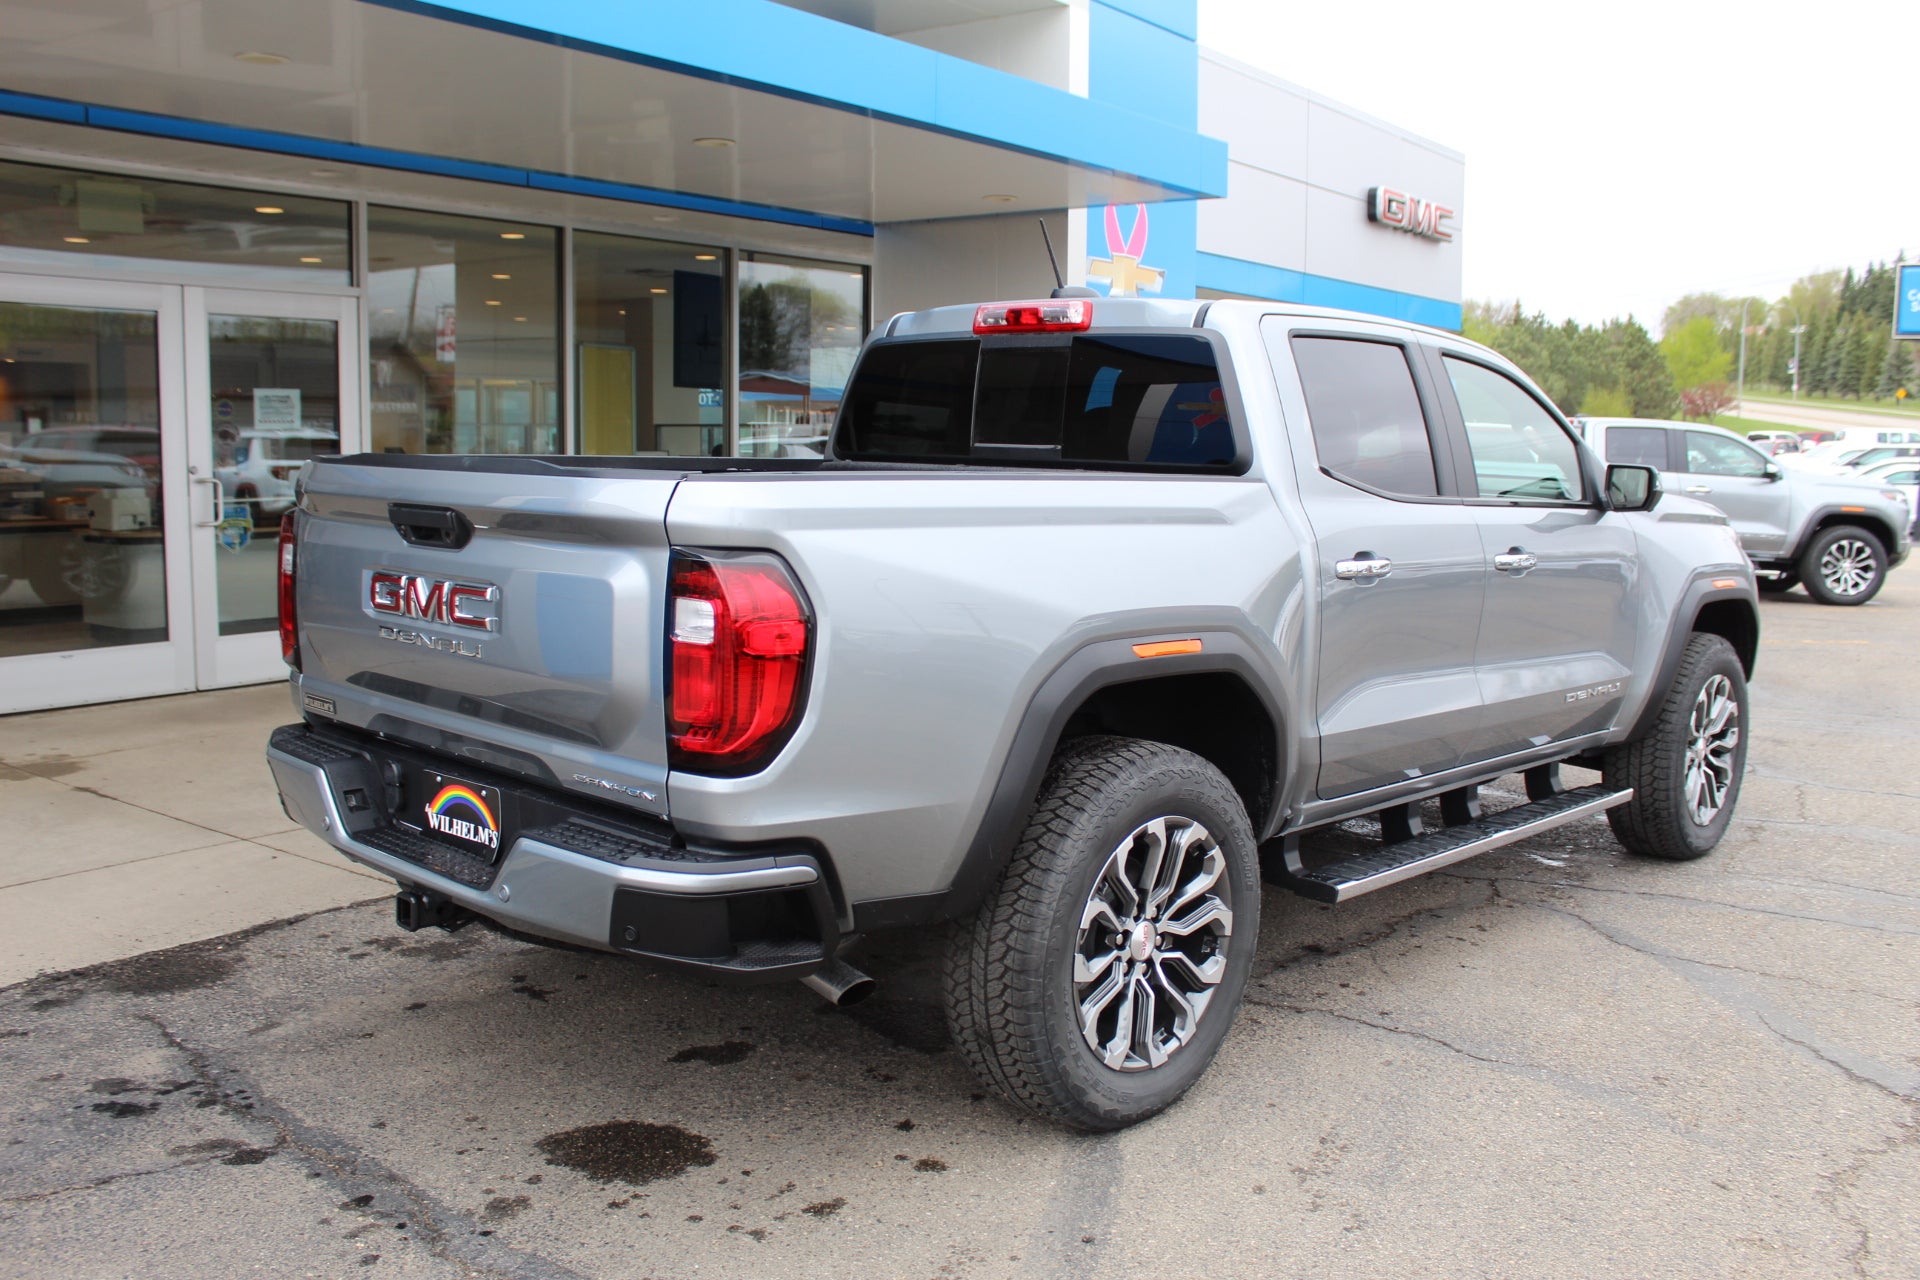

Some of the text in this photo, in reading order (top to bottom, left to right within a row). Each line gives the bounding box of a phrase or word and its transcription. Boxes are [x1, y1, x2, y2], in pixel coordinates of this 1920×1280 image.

[1376, 186, 1456, 242] GMC
[370, 572, 500, 632] GMC
[379, 625, 484, 659] DENALI
[1564, 682, 1621, 703] DENALI
[573, 773, 656, 802] CANYON
[426, 809, 499, 849] WILHELM'S
[1141, 924, 1149, 958] GMC
